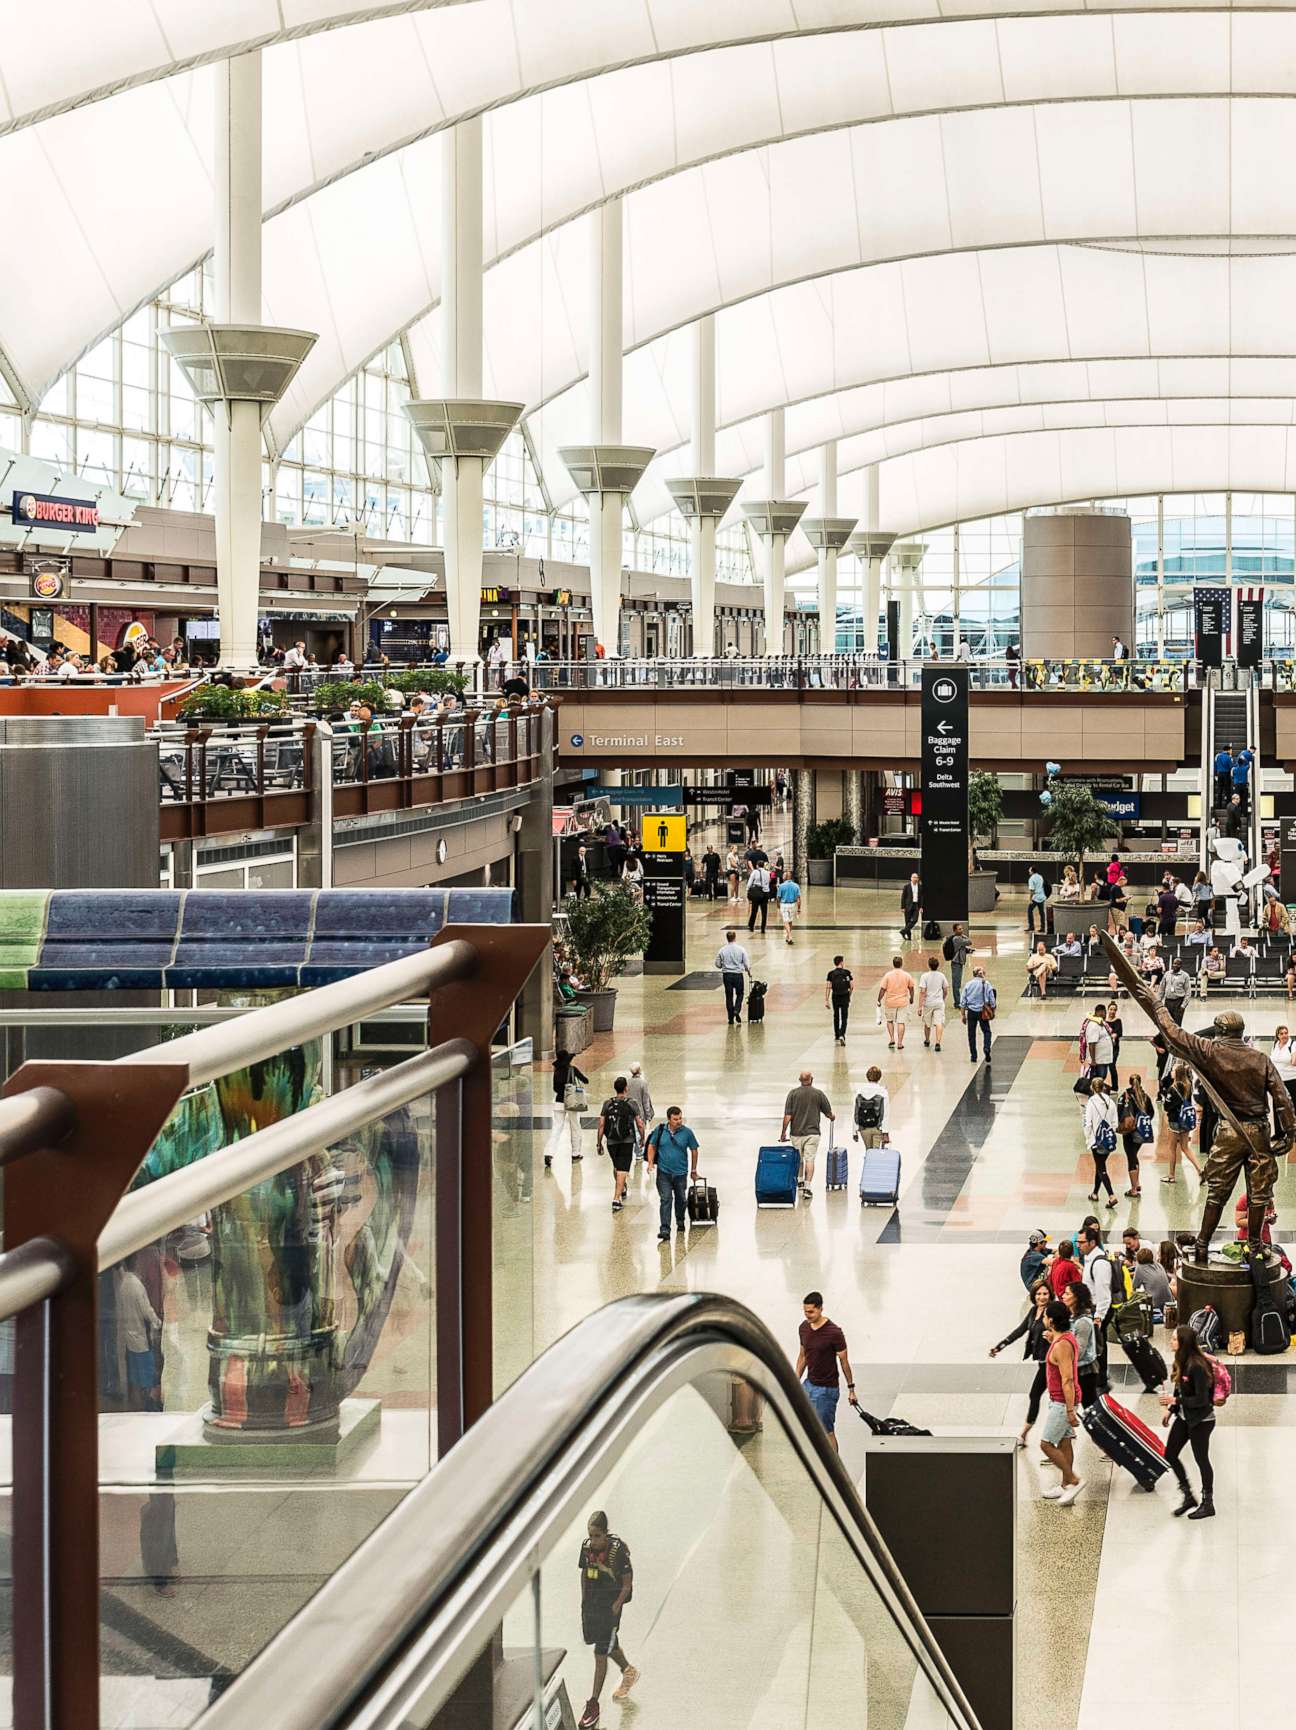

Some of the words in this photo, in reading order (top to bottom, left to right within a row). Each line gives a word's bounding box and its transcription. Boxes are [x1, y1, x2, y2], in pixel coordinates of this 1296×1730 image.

[36, 501, 74, 523] BURGER
[75, 506, 100, 527] KING
[588, 734, 649, 747] Terminal
[655, 735, 685, 747] East
[928, 736, 962, 746] Baggage
[933, 745, 956, 754] Claim
[935, 756, 954, 766] 6-9
[936, 773, 953, 781] Delta
[928, 781, 960, 789] Southwest
[885, 788, 903, 797] AVIS
